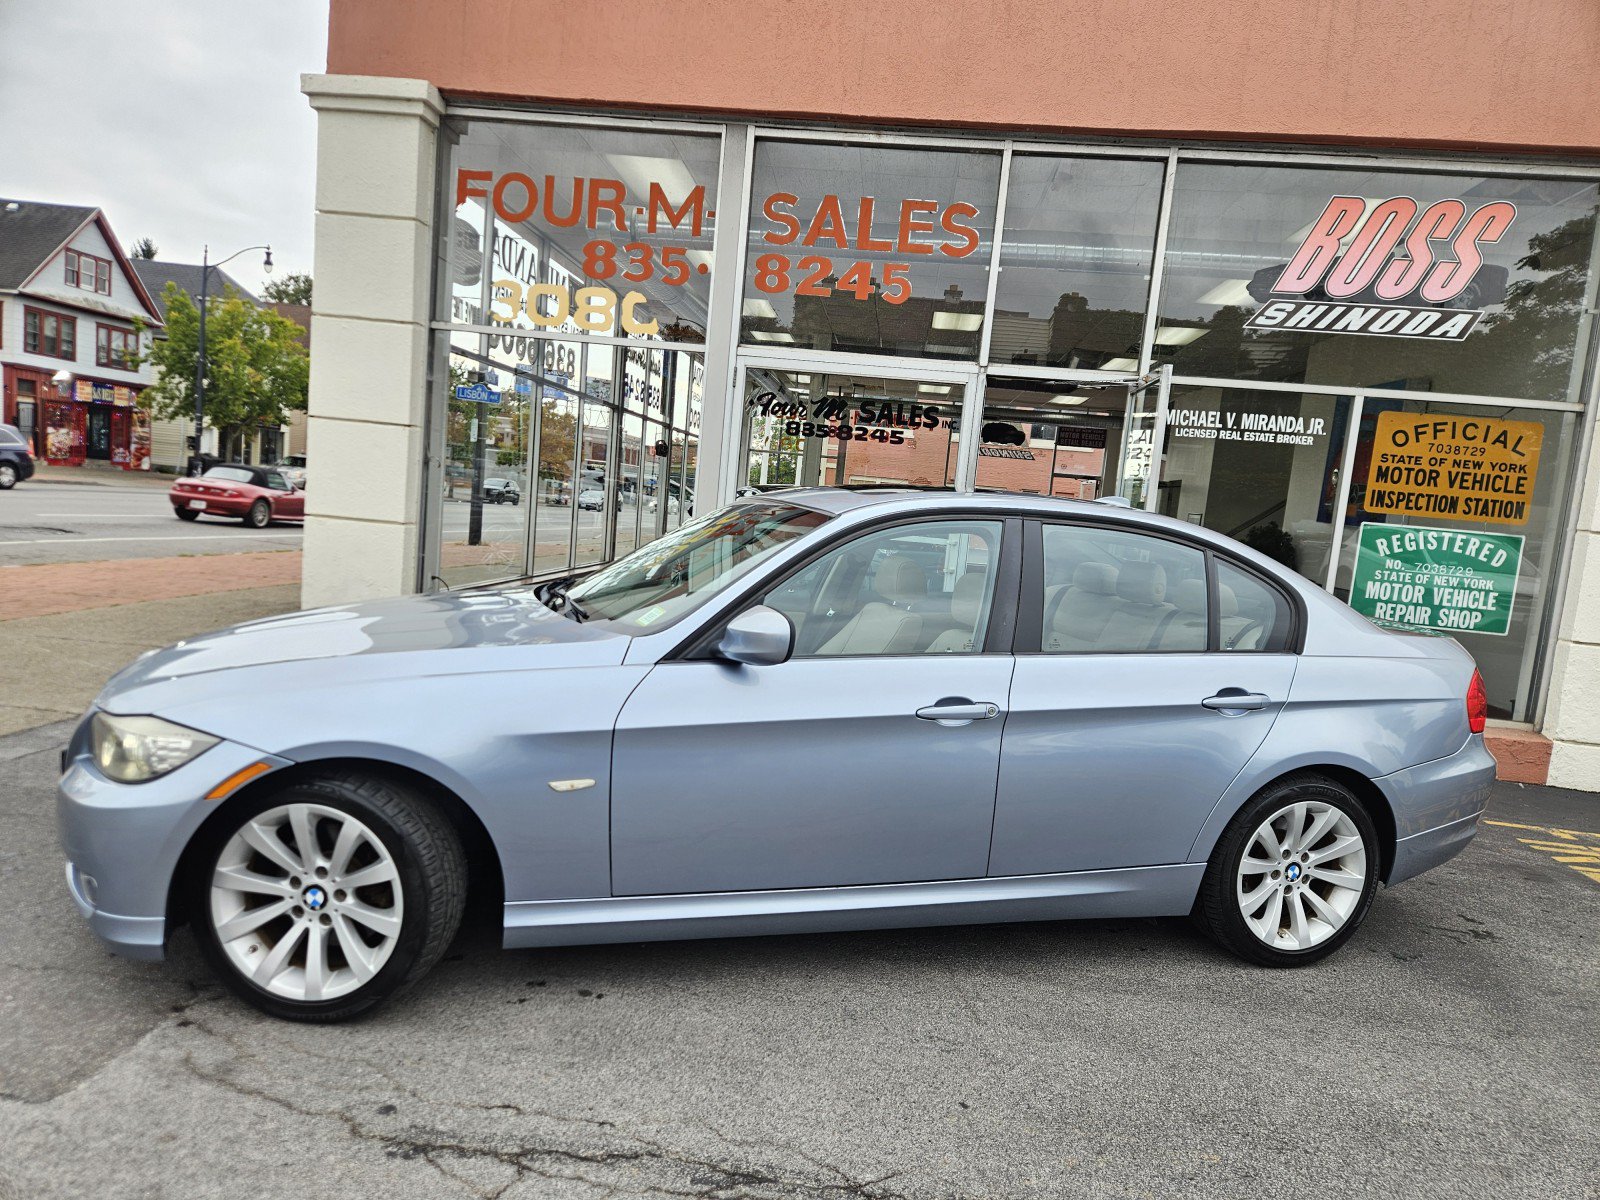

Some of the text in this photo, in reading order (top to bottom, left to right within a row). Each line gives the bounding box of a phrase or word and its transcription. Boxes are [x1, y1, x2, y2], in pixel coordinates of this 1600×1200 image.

[762, 192, 980, 258] SALES
[1270, 195, 1517, 303] BOSS
[754, 253, 912, 304] 8245
[1255, 303, 1474, 338] SHINODA
[460, 388, 488, 401] LISBON
[860, 400, 940, 429] SALES
[1166, 409, 1327, 436] MICHAEL V. MIRANDA JR.
[1175, 427, 1315, 446] LICENSED REAL ESTATE BROKER
[1391, 421, 1526, 458] OFFICIAL
[1428, 442, 1487, 457] 7038729
[1380, 453, 1528, 474] STATE OF NEW YORK
[1375, 465, 1528, 495] MOTOR VEHICLE
[1369, 489, 1526, 520] INSPECTION STATION
[1375, 531, 1508, 568] REGISTERED
[1374, 570, 1495, 591] STATE OF NEW YORK
[1385, 559, 1474, 576] NO. 7038729
[1365, 581, 1499, 611] MOTOR VEHICLE
[1374, 602, 1482, 630] REPAIR SHOP
